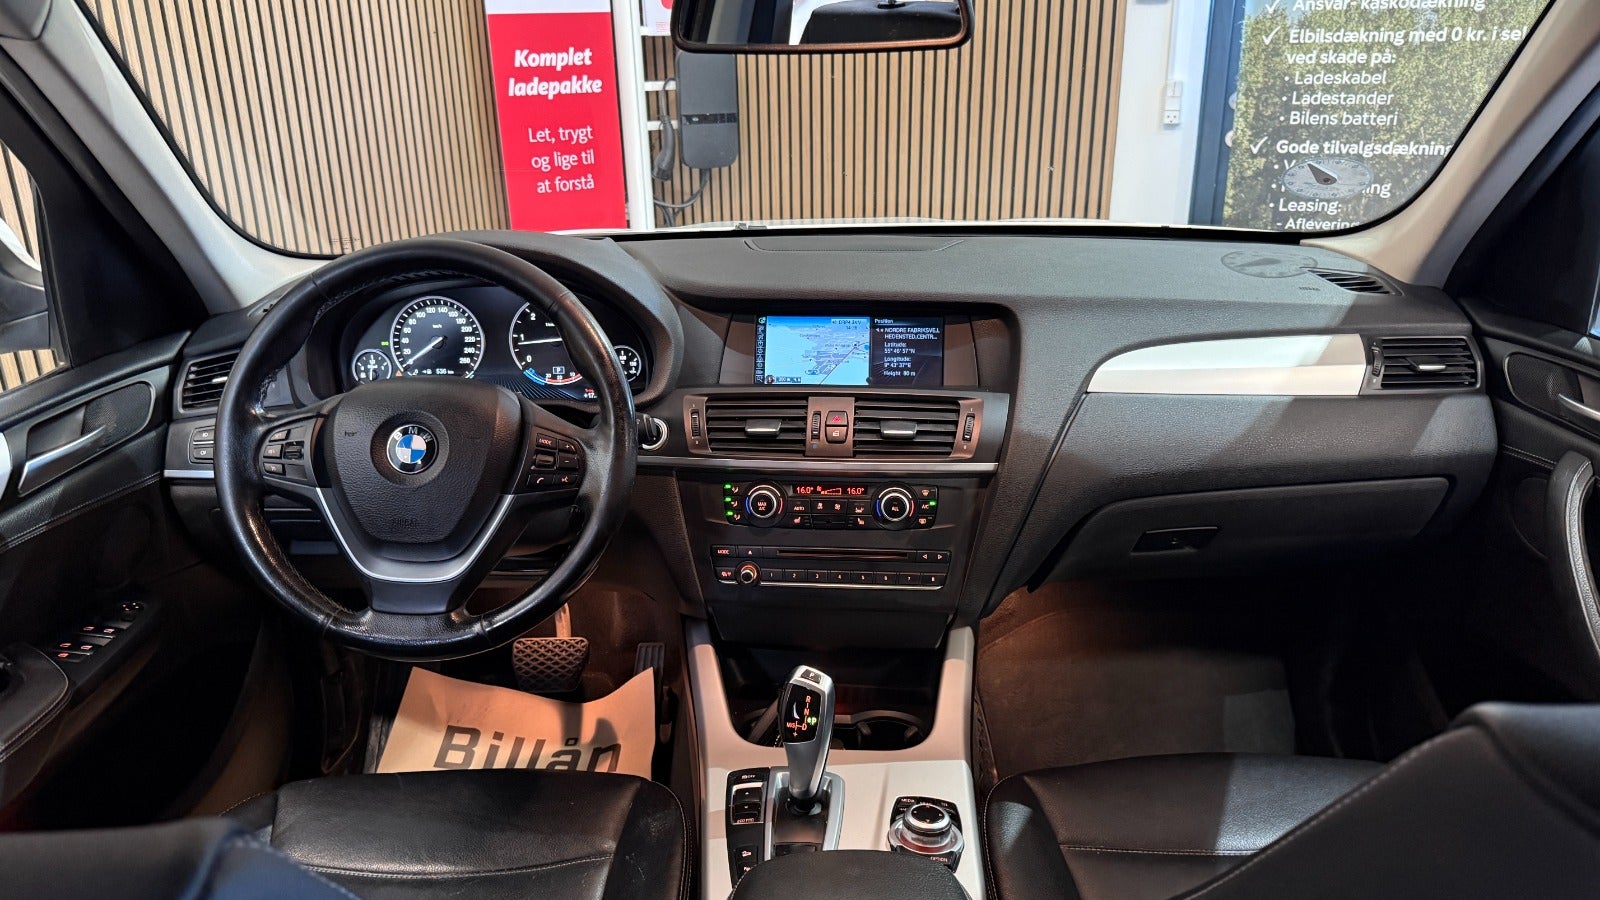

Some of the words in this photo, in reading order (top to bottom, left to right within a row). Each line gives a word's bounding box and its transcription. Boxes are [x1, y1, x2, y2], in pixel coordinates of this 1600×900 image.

[1361, 0, 1486, 11] kaskodækning
[1289, 28, 1404, 46] Elbilsdækning
[1408, 27, 1448, 42] med
[1451, 27, 1462, 42] 0
[1466, 27, 1487, 42] kr.
[1492, 26, 1498, 41] i
[514, 47, 592, 72] Komplet
[1287, 50, 1316, 64] ved
[1320, 50, 1366, 64] skade
[1370, 48, 1396, 67] på:
[1294, 70, 1387, 86] Ladeskabel
[508, 76, 602, 100] ladepakke
[1292, 91, 1394, 106] Ladestander
[1290, 112, 1338, 126] Bilens
[1344, 112, 1398, 126] batteri
[528, 128, 556, 144] Let,
[559, 125, 594, 145] trygt
[1276, 140, 1320, 155] Gode
[532, 154, 551, 172] og
[554, 151, 578, 170] lige
[580, 149, 595, 166] til
[537, 178, 552, 194] at
[555, 174, 595, 191] forstå
[1279, 199, 1342, 214] Leasing:
[394, 426, 434, 442] BMW
[434, 725, 622, 772] Billån
